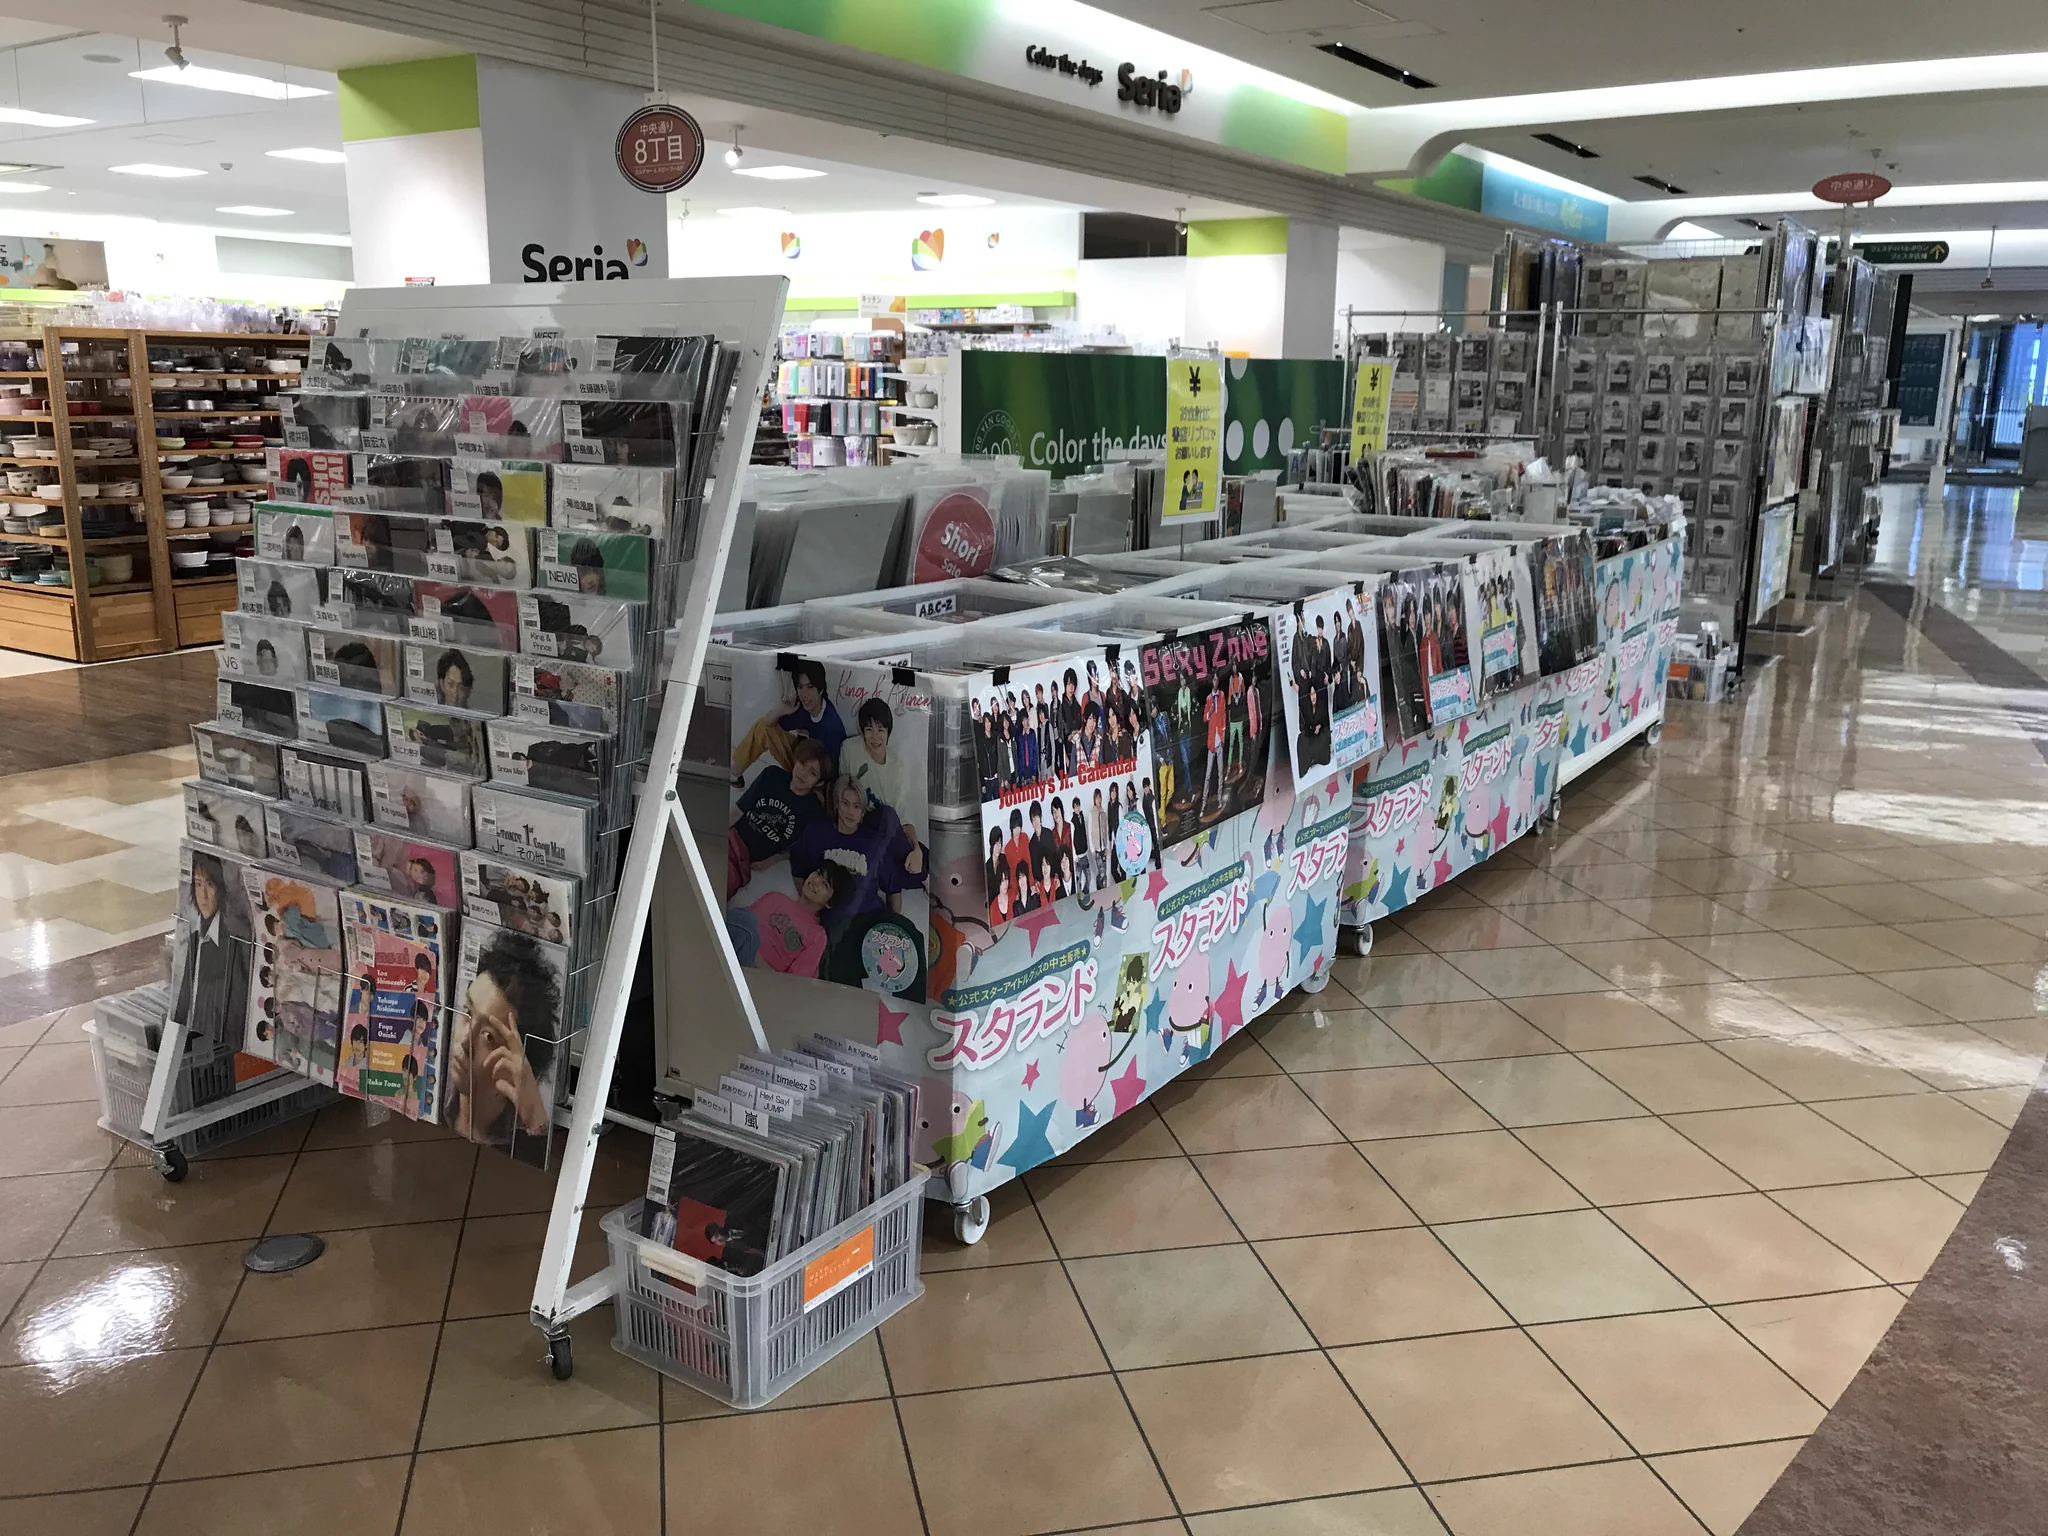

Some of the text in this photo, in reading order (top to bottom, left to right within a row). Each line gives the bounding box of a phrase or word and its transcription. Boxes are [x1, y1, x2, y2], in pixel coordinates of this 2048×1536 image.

[1026, 45, 1103, 86] Color the days
[1118, 62, 1181, 114] Seria
[640, 121, 673, 135] 中央通り
[635, 135, 682, 164] 8丁目
[1831, 179, 1874, 191] 中央通り
[522, 243, 629, 283] Seria
[1189, 366, 1201, 397] ¥
[1030, 430, 1088, 466] Color
[1092, 427, 1123, 461] the
[312, 455, 330, 505] SHO
[941, 522, 982, 567] Shori
[550, 571, 578, 584] NEWS
[941, 559, 961, 578] Sato
[530, 632, 545, 642] King
[533, 641, 552, 651] Prince
[222, 655, 239, 670] V6
[497, 764, 526, 776] Snow Man
[999, 755, 1137, 809] Johnny's Jr. Calendar
[1350, 778, 1432, 834] スタランド
[491, 838, 545, 865] Jr. その他
[872, 931, 910, 950] スタランド
[1152, 883, 1249, 975] スタランド
[931, 963, 1096, 1064] スタランド
[739, 1063, 808, 1091] 訳ありセット timelesz
[823, 1062, 838, 1074] King
[384, 1080, 401, 1088] Toma
[721, 1083, 790, 1107] 訳ありセット Hey! Say!
[697, 1096, 759, 1130] 訳ありセット 嵐
[763, 1103, 785, 1114] JUMP
